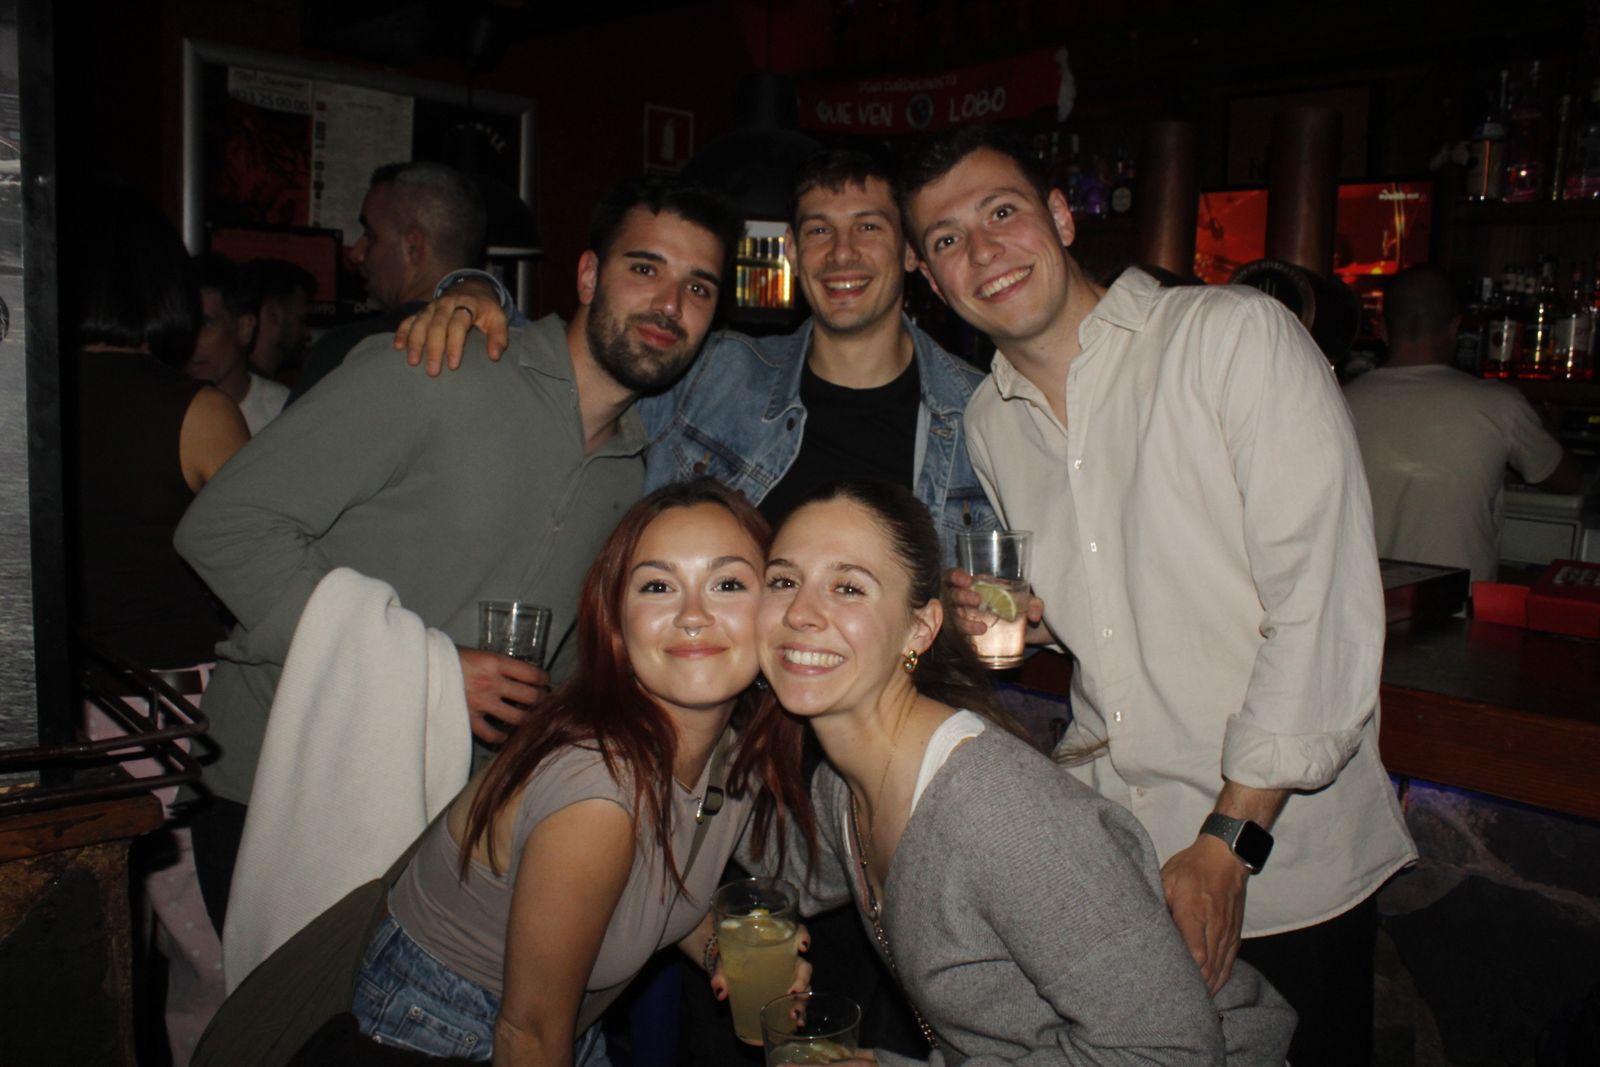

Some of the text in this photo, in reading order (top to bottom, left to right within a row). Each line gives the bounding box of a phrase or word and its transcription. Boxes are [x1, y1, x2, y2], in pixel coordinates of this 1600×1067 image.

[816, 86, 1007, 128] QUE VEN LOBO
